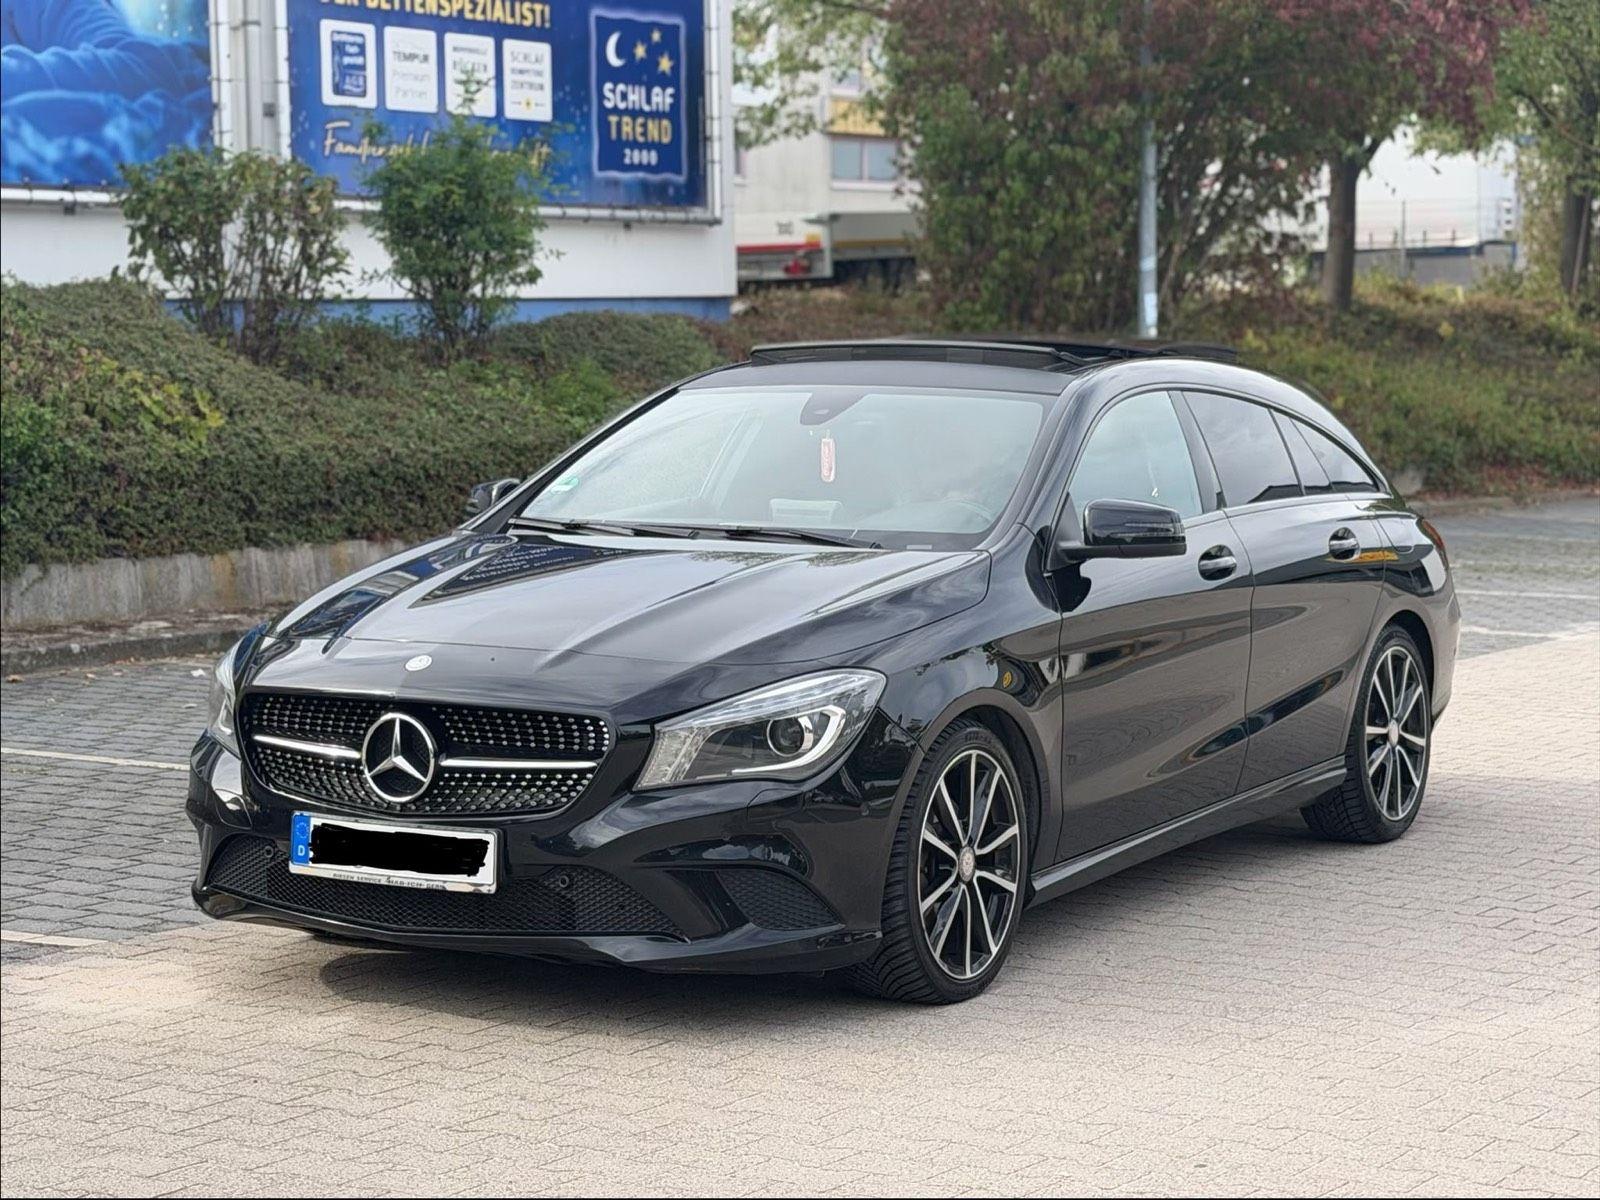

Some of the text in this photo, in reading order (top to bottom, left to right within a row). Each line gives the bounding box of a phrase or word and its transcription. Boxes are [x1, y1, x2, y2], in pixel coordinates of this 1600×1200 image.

[602, 82, 675, 112] SCHLAF
[607, 114, 672, 144] TREND
[623, 148, 658, 166] 2000
[297, 844, 305, 857] D
